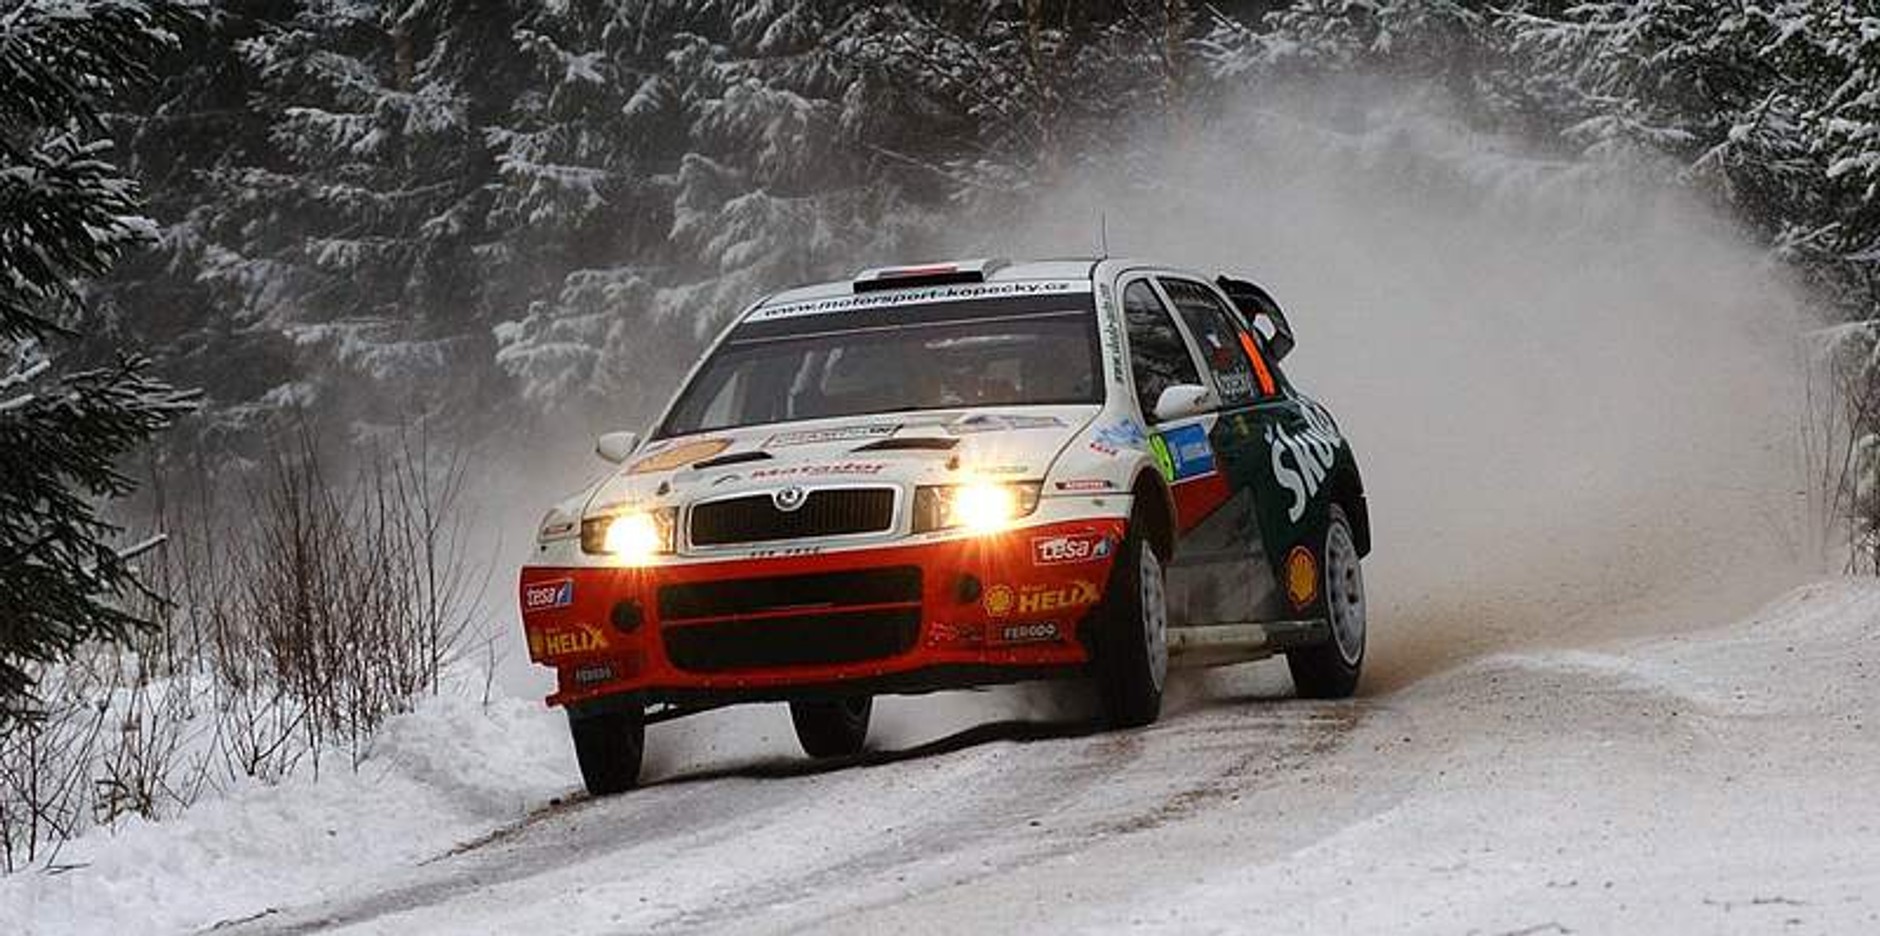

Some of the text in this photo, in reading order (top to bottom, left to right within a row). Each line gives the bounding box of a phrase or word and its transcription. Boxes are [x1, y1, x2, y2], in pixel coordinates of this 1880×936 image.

[1038, 538, 1089, 560] tesa
[526, 587, 556, 607] tesa
[1019, 579, 1101, 613] HELIX
[545, 623, 609, 655] HELIX
